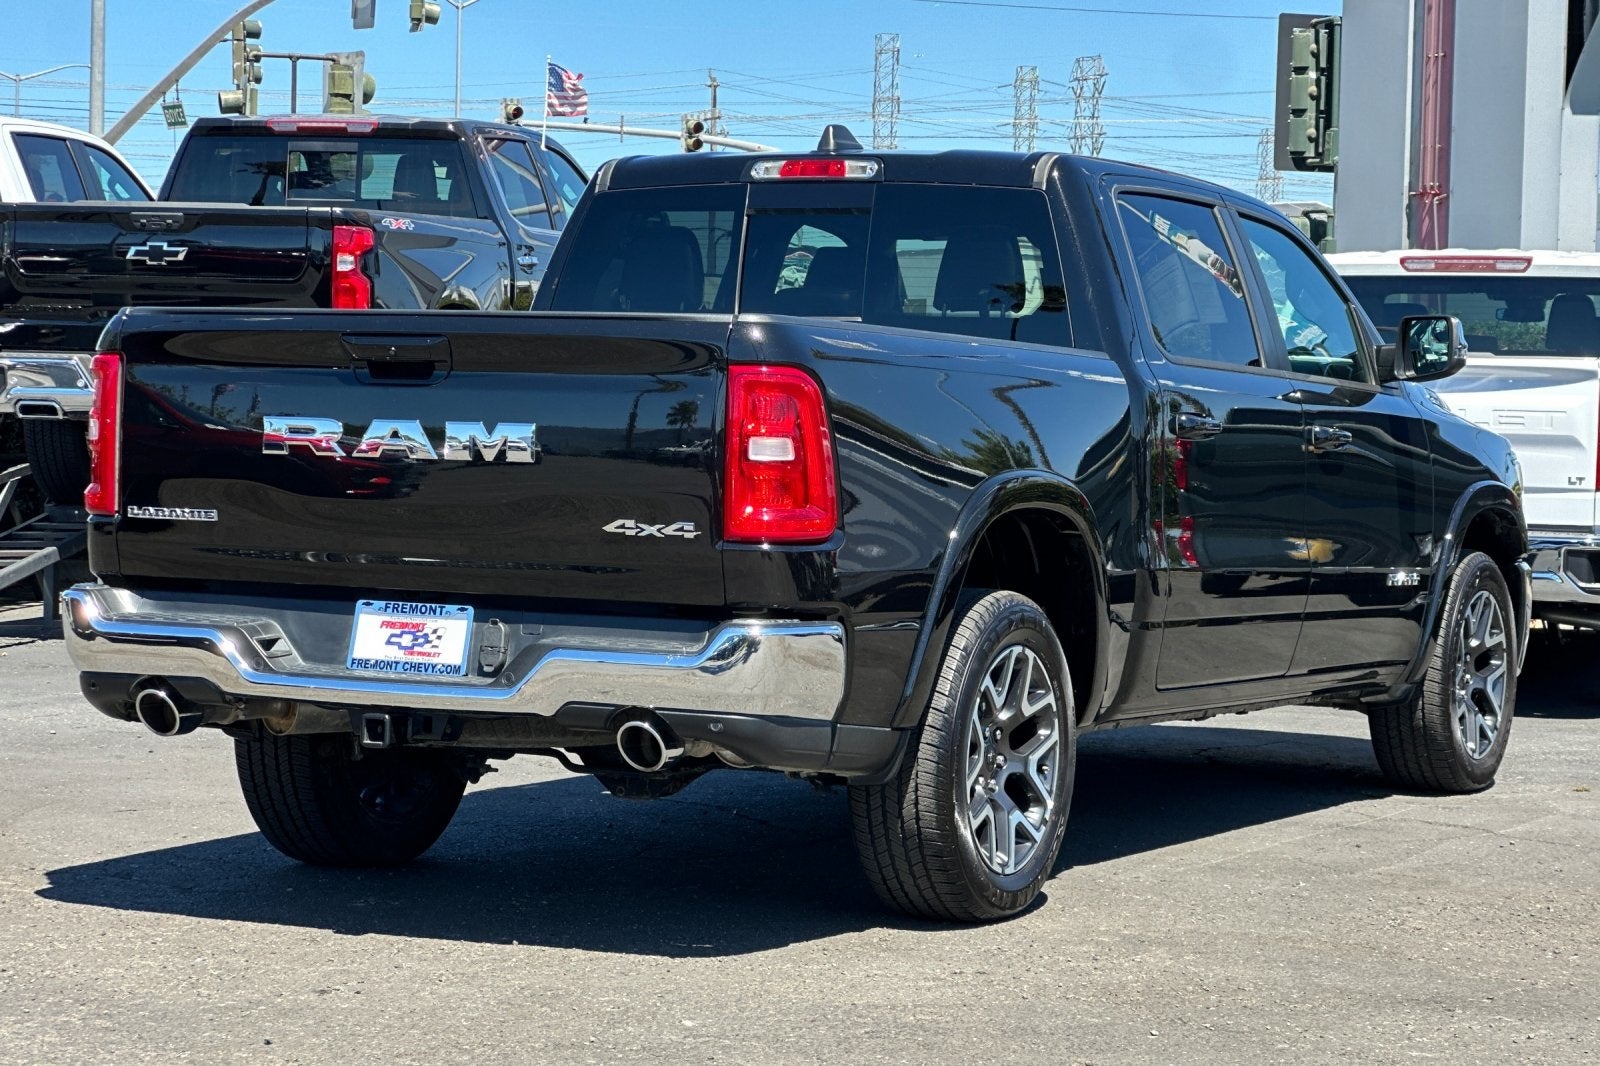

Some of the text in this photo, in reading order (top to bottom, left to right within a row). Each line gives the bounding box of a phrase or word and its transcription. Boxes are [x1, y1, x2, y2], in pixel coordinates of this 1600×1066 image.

[262, 415, 536, 463] RAM
[1568, 476, 1586, 486] LT
[127, 505, 219, 521] LARAMIE
[383, 602, 446, 616] FREMONT
[380, 620, 427, 632] FREMONT
[403, 650, 441, 658] CHEVROLET
[350, 658, 461, 675] FREMONT CHEVY.COM
